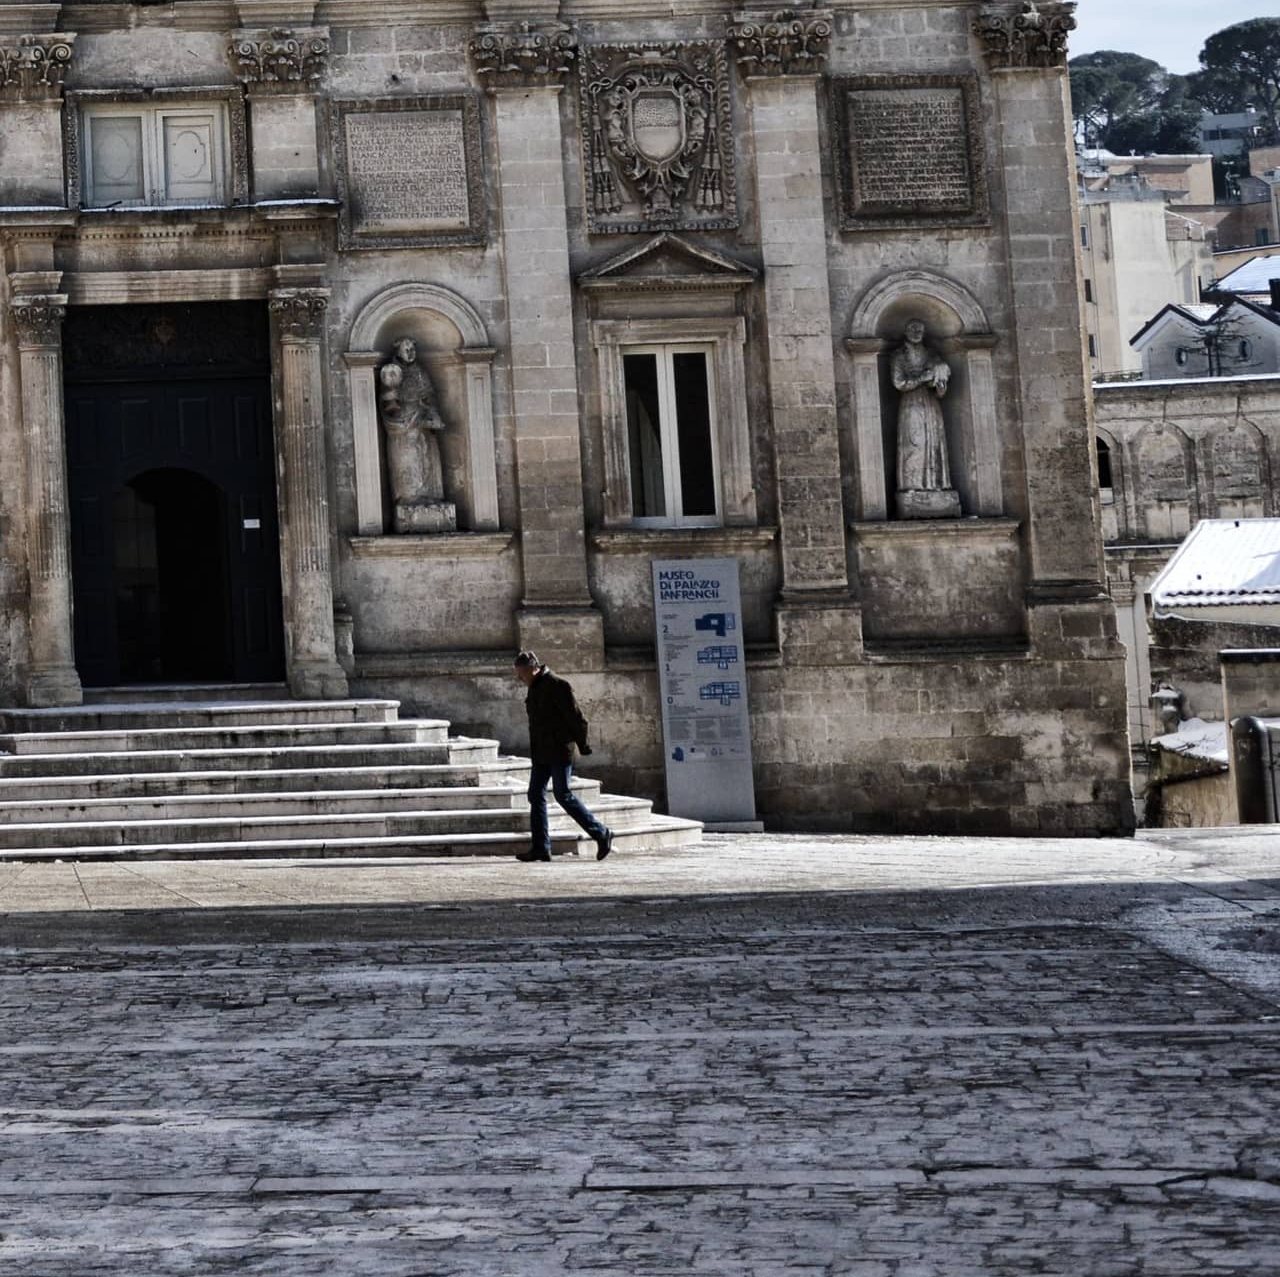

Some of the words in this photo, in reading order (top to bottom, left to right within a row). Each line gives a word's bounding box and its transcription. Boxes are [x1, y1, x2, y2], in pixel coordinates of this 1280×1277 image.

[659, 571, 695, 581] MUSEO
[674, 580, 720, 590] PALAZZO
[663, 625, 669, 634] 2
